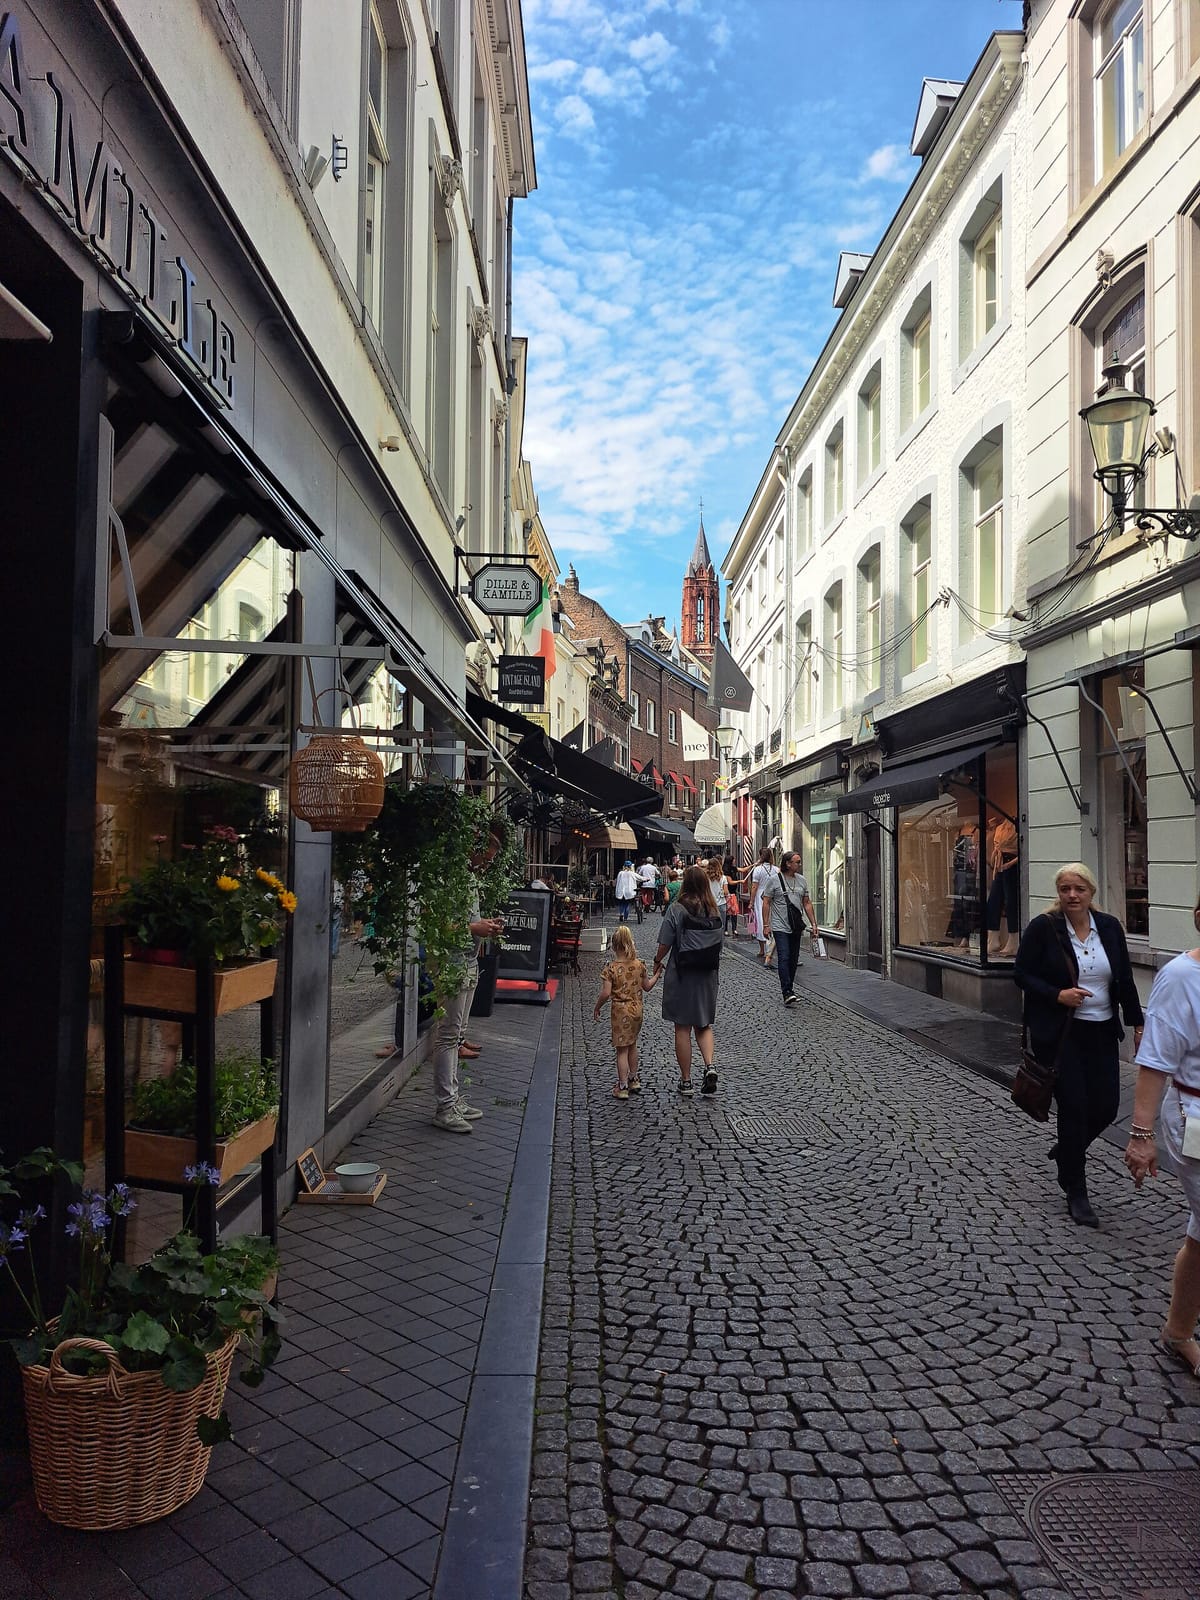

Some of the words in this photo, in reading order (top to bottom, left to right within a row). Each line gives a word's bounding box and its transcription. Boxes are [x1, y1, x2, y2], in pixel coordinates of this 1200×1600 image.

[486, 579, 518, 590] DILLE
[521, 580, 530, 590] &
[483, 589, 532, 600] KAMILLE
[502, 674, 523, 687] VINTAGE
[523, 674, 541, 688] ISLAND
[684, 743, 709, 753] mey
[519, 917, 538, 930] ISLAND
